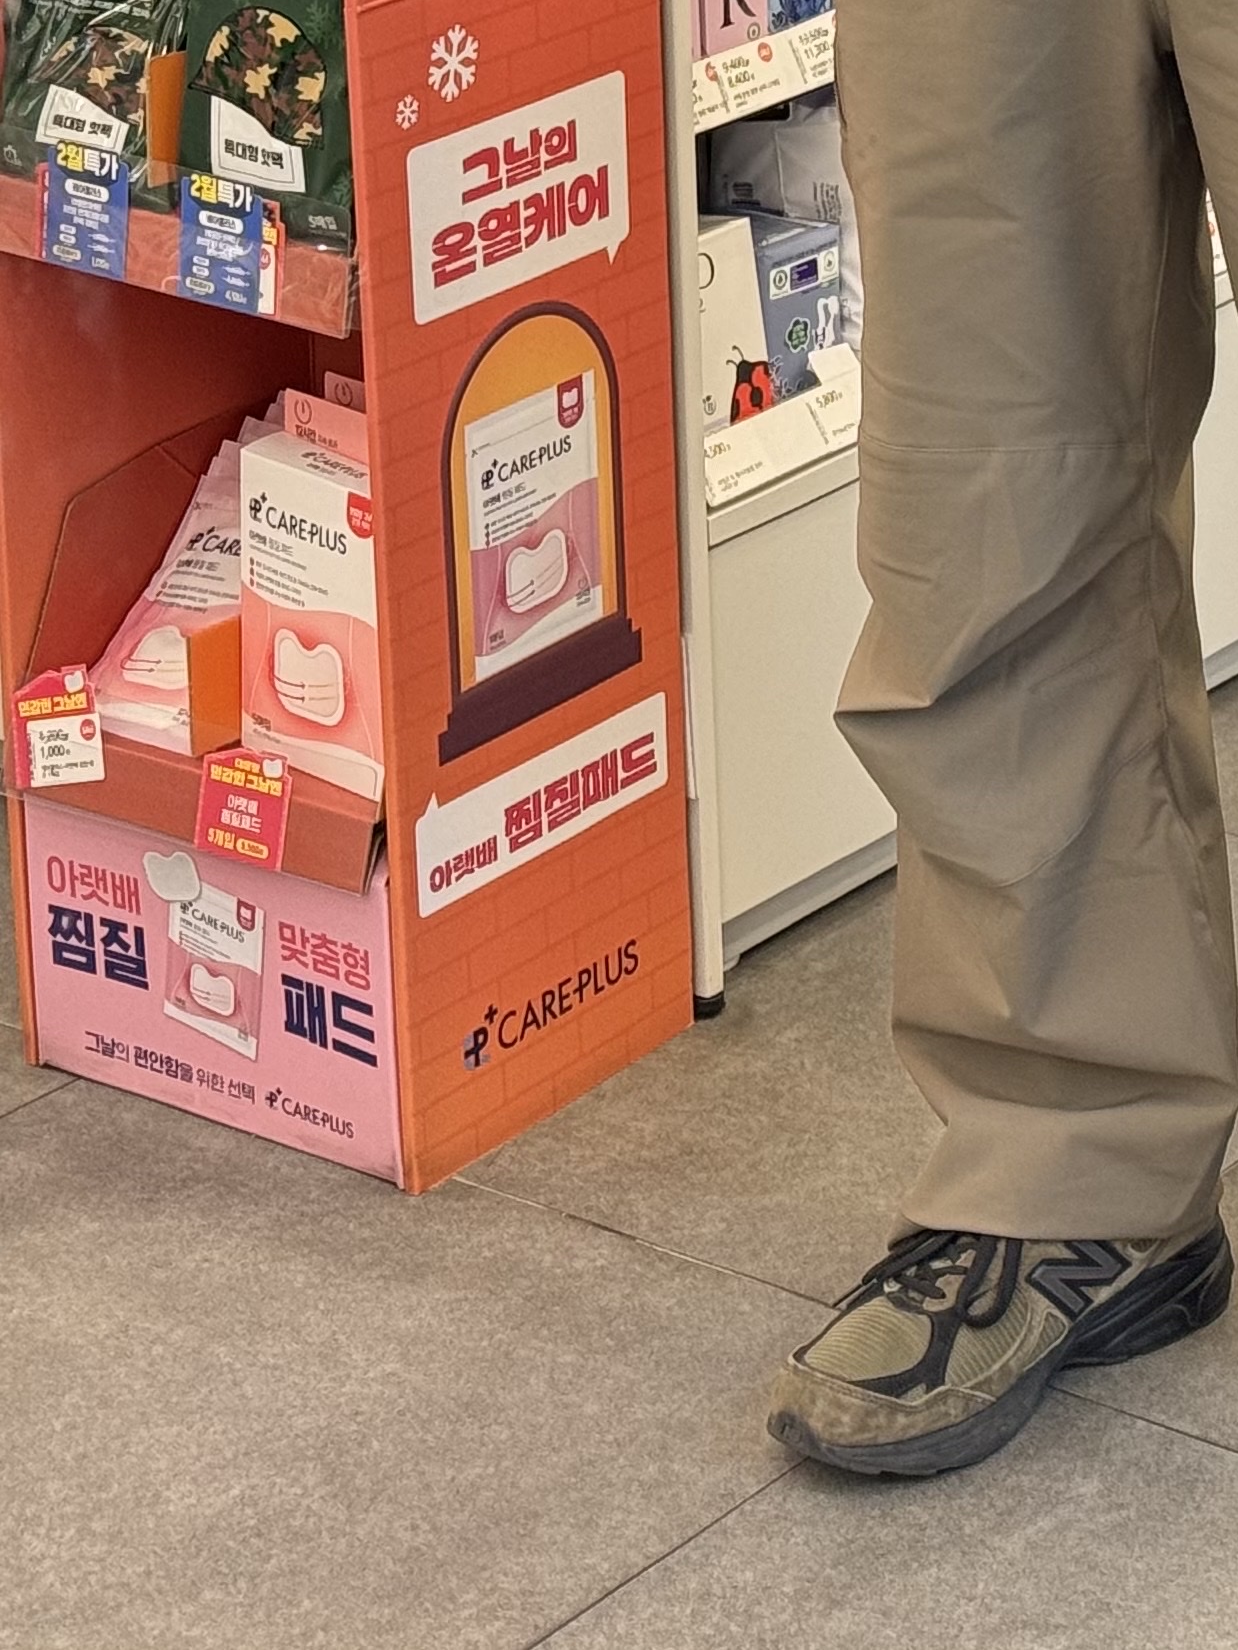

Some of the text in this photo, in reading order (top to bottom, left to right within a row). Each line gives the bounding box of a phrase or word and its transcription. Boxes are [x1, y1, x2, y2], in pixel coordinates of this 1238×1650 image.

[56, 142, 119, 181] 2월특가
[190, 173, 253, 213] 2월특가
[462, 118, 577, 206] 그날의
[431, 164, 610, 290] 온열케어
[428, 731, 658, 893] 아랫배 찜질패드
[47, 855, 142, 916] 아랫배
[48, 904, 150, 991] 찜질
[278, 920, 371, 991] 맞춤형
[280, 973, 378, 1068] 패드
[85, 1030, 256, 1104] 그날의 편안함을 위한 선택
